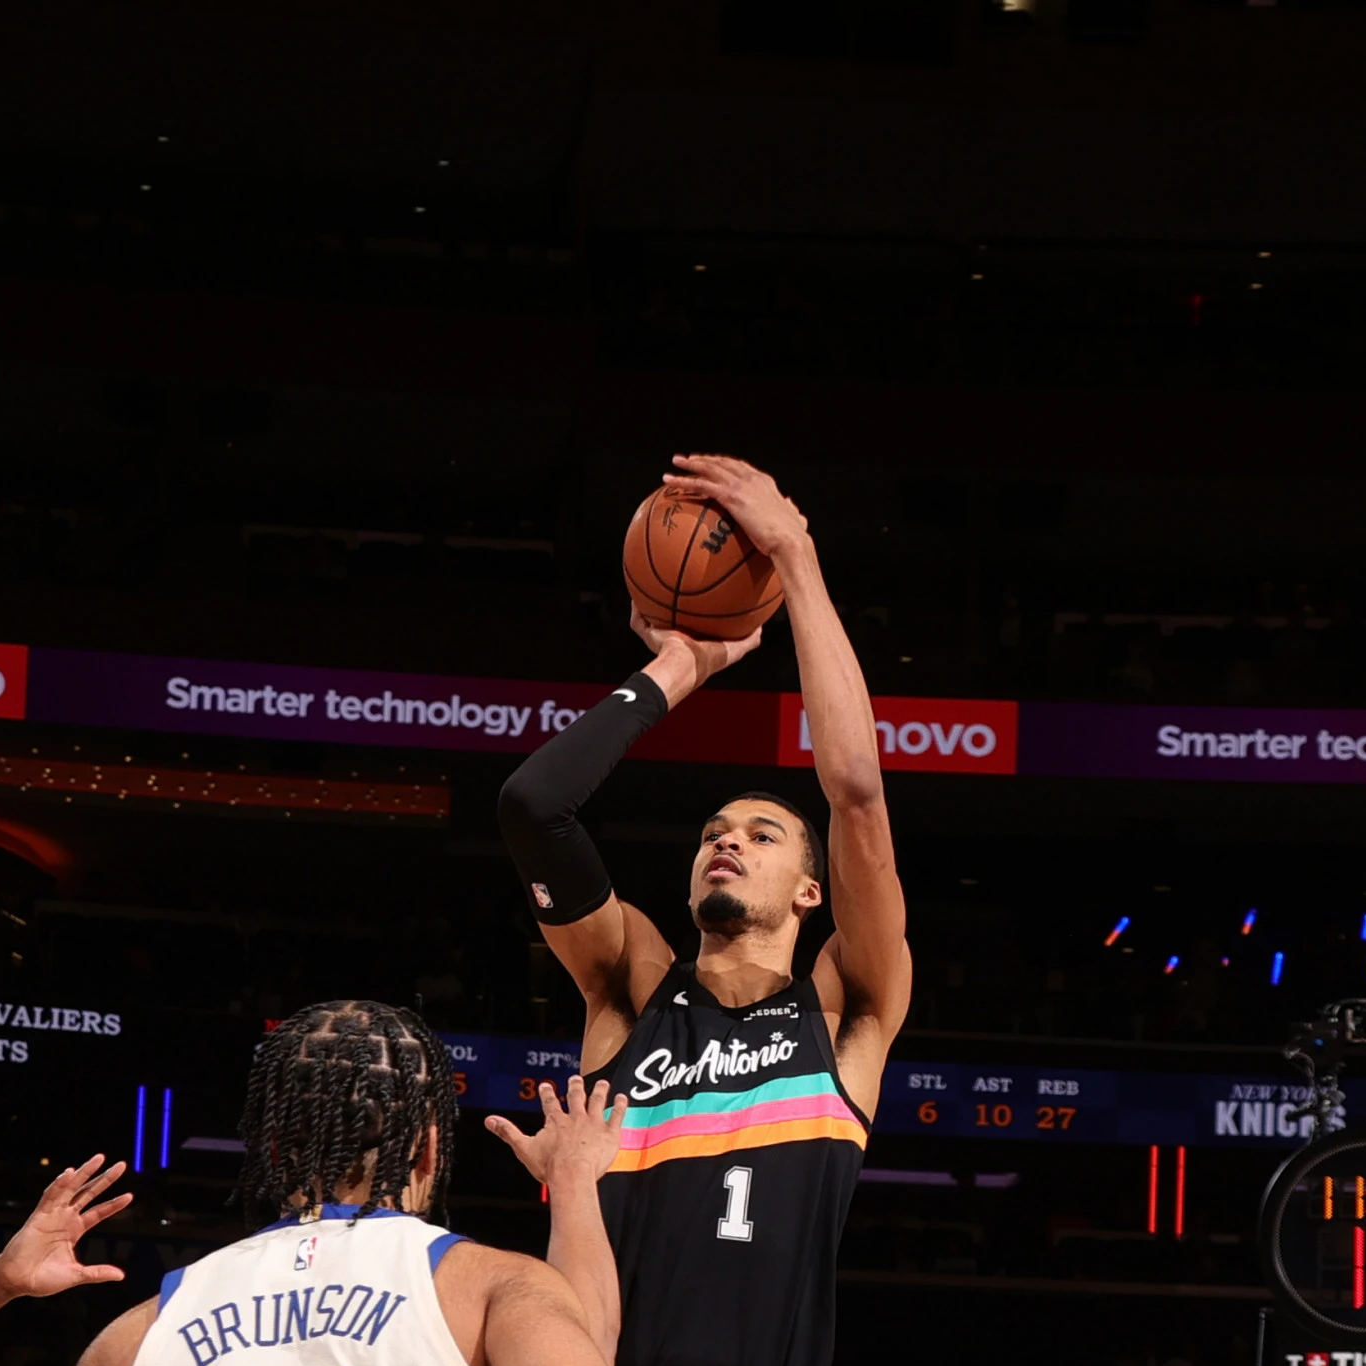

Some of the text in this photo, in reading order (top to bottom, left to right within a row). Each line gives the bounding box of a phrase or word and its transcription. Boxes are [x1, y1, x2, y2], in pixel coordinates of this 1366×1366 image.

[165, 676, 587, 738] Smarter technology fo
[1156, 724, 1308, 759] Smarter
[630, 1031, 798, 1100] San Antonio
[908, 1073, 1080, 1096] STL AST REB
[1229, 1084, 1276, 1100] NEW
[917, 1100, 1077, 1130] 6 10 27
[716, 1165, 753, 1242] 1
